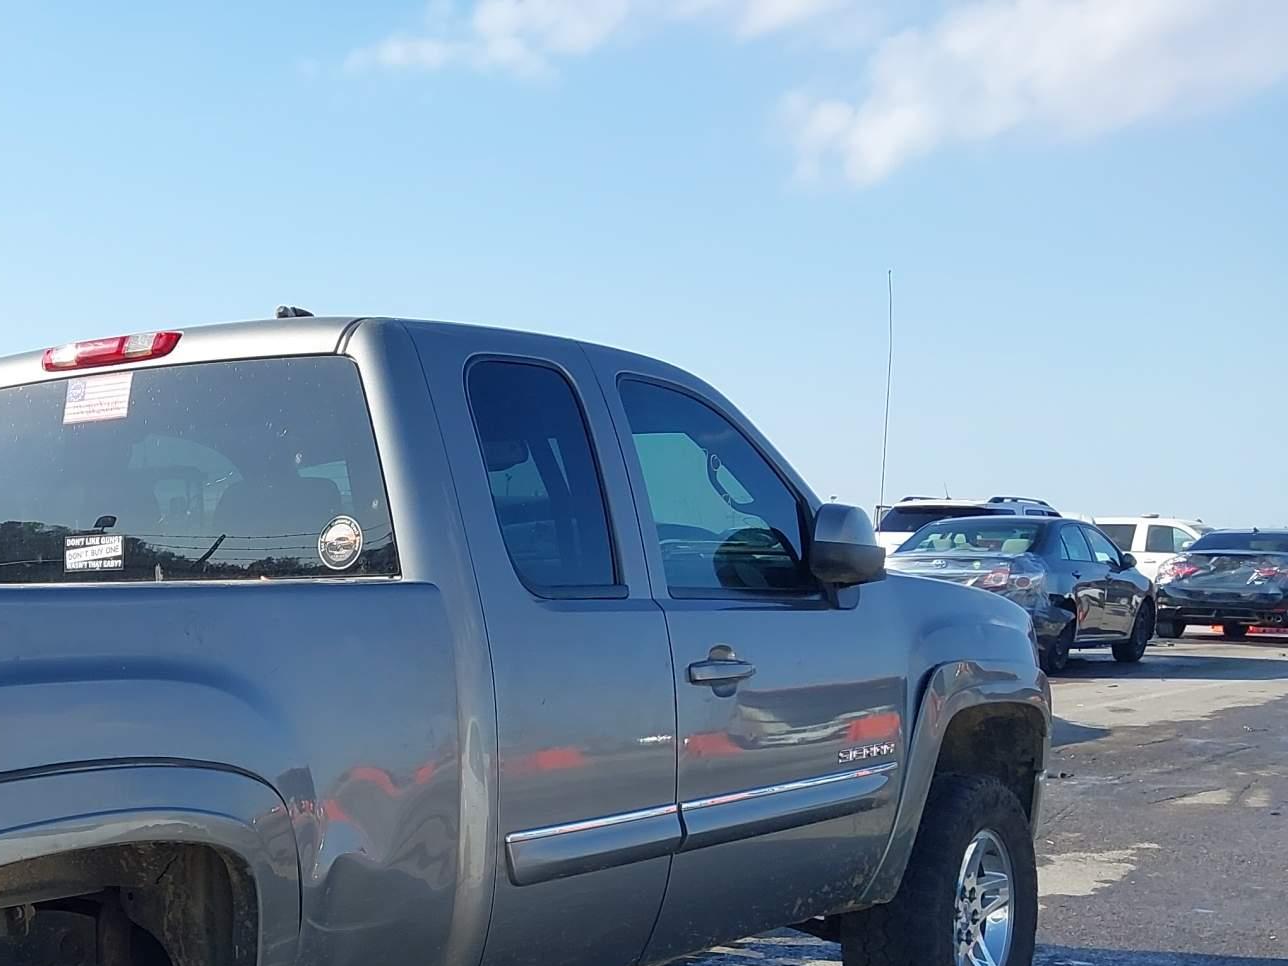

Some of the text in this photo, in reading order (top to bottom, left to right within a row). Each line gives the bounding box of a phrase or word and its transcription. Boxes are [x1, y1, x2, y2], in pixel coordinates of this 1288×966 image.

[67, 537, 85, 547] DON'T
[85, 536, 101, 546] LIKE
[90, 547, 104, 557] BUY
[105, 544, 120, 554] ONE
[88, 560, 103, 569] THAT
[838, 743, 896, 764] SIERRA
